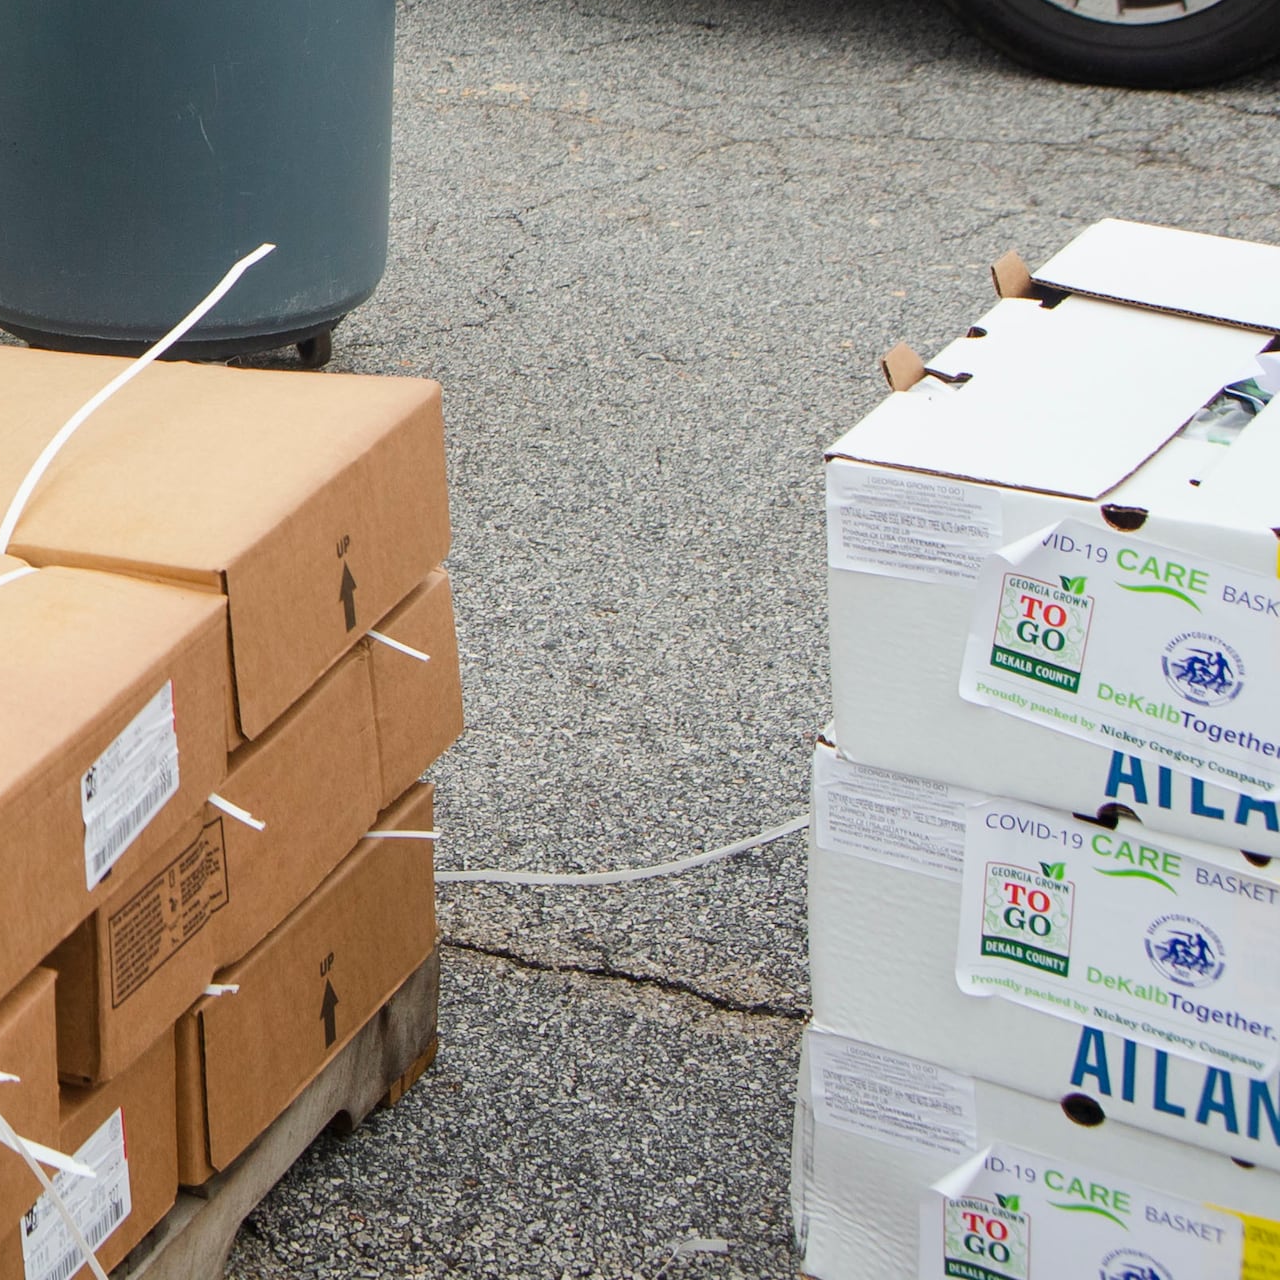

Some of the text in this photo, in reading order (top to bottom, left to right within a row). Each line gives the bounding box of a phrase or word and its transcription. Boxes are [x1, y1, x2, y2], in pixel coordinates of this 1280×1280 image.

[336, 534, 350, 559] UP
[1042, 532, 1280, 618] VID-19 CARE BASK
[1008, 576, 1088, 609] GEORGIA GROWN
[1020, 595, 1067, 628] TO
[1015, 620, 1065, 652] GO
[995, 652, 1077, 688] DEKALB COUNTY
[976, 681, 1026, 708] Proudly
[1031, 701, 1077, 724] packed
[1100, 723, 1147, 748] Nickey
[1149, 741, 1205, 768] Gregory
[1209, 761, 1274, 791] Company
[1097, 683, 1280, 760] DeKalbTogether
[986, 813, 1278, 905] COVID-19 CARE BASKET
[991, 865, 1070, 894] GEORGIA GROWN
[1004, 882, 1050, 913] TO
[1003, 911, 1051, 937] GO
[320, 951, 334, 978] UP
[985, 939, 1066, 973] DEKALB COUNTY
[971, 974, 1022, 995] Proudly
[1023, 984, 1069, 1008] packed
[1093, 1005, 1138, 1030] Nickey
[1141, 1018, 1196, 1050] Gregory
[1199, 1038, 1266, 1072] Company
[949, 1198, 1026, 1224] GEORGIA GROWN
[984, 1154, 1226, 1244] ID-19 CARE BASKET
[962, 1212, 1007, 1242] TO
[964, 1234, 1010, 1263] GO
